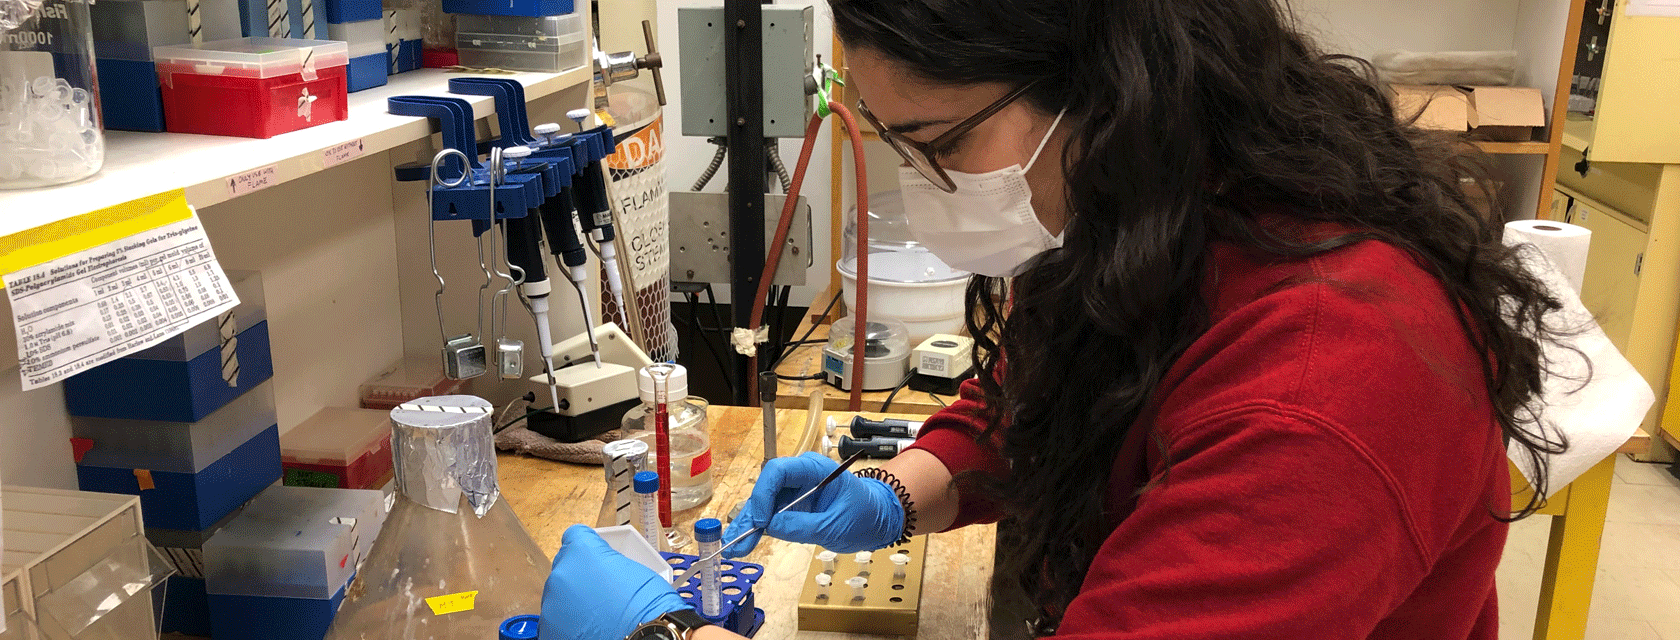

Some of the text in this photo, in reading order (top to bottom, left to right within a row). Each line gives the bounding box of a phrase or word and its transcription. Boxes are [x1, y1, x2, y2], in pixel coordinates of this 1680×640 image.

[622, 123, 664, 169] DA
[9, 276, 31, 289] TABLE
[50, 263, 78, 275] Solutions
[79, 258, 88, 266] for
[89, 251, 116, 265] Preparing
[124, 241, 146, 252] Stacking
[146, 238, 158, 246] Gels
[166, 226, 198, 239] Tris-glycine
[11, 255, 127, 296] SDS-Polyacrylamide Gel Electrophoresis
[91, 268, 118, 283] Component
[119, 264, 138, 273] volumes
[17, 298, 78, 322] Solution components
[35, 324, 64, 339] acrylamide
[29, 376, 50, 385] Tables
[64, 366, 73, 374] and
